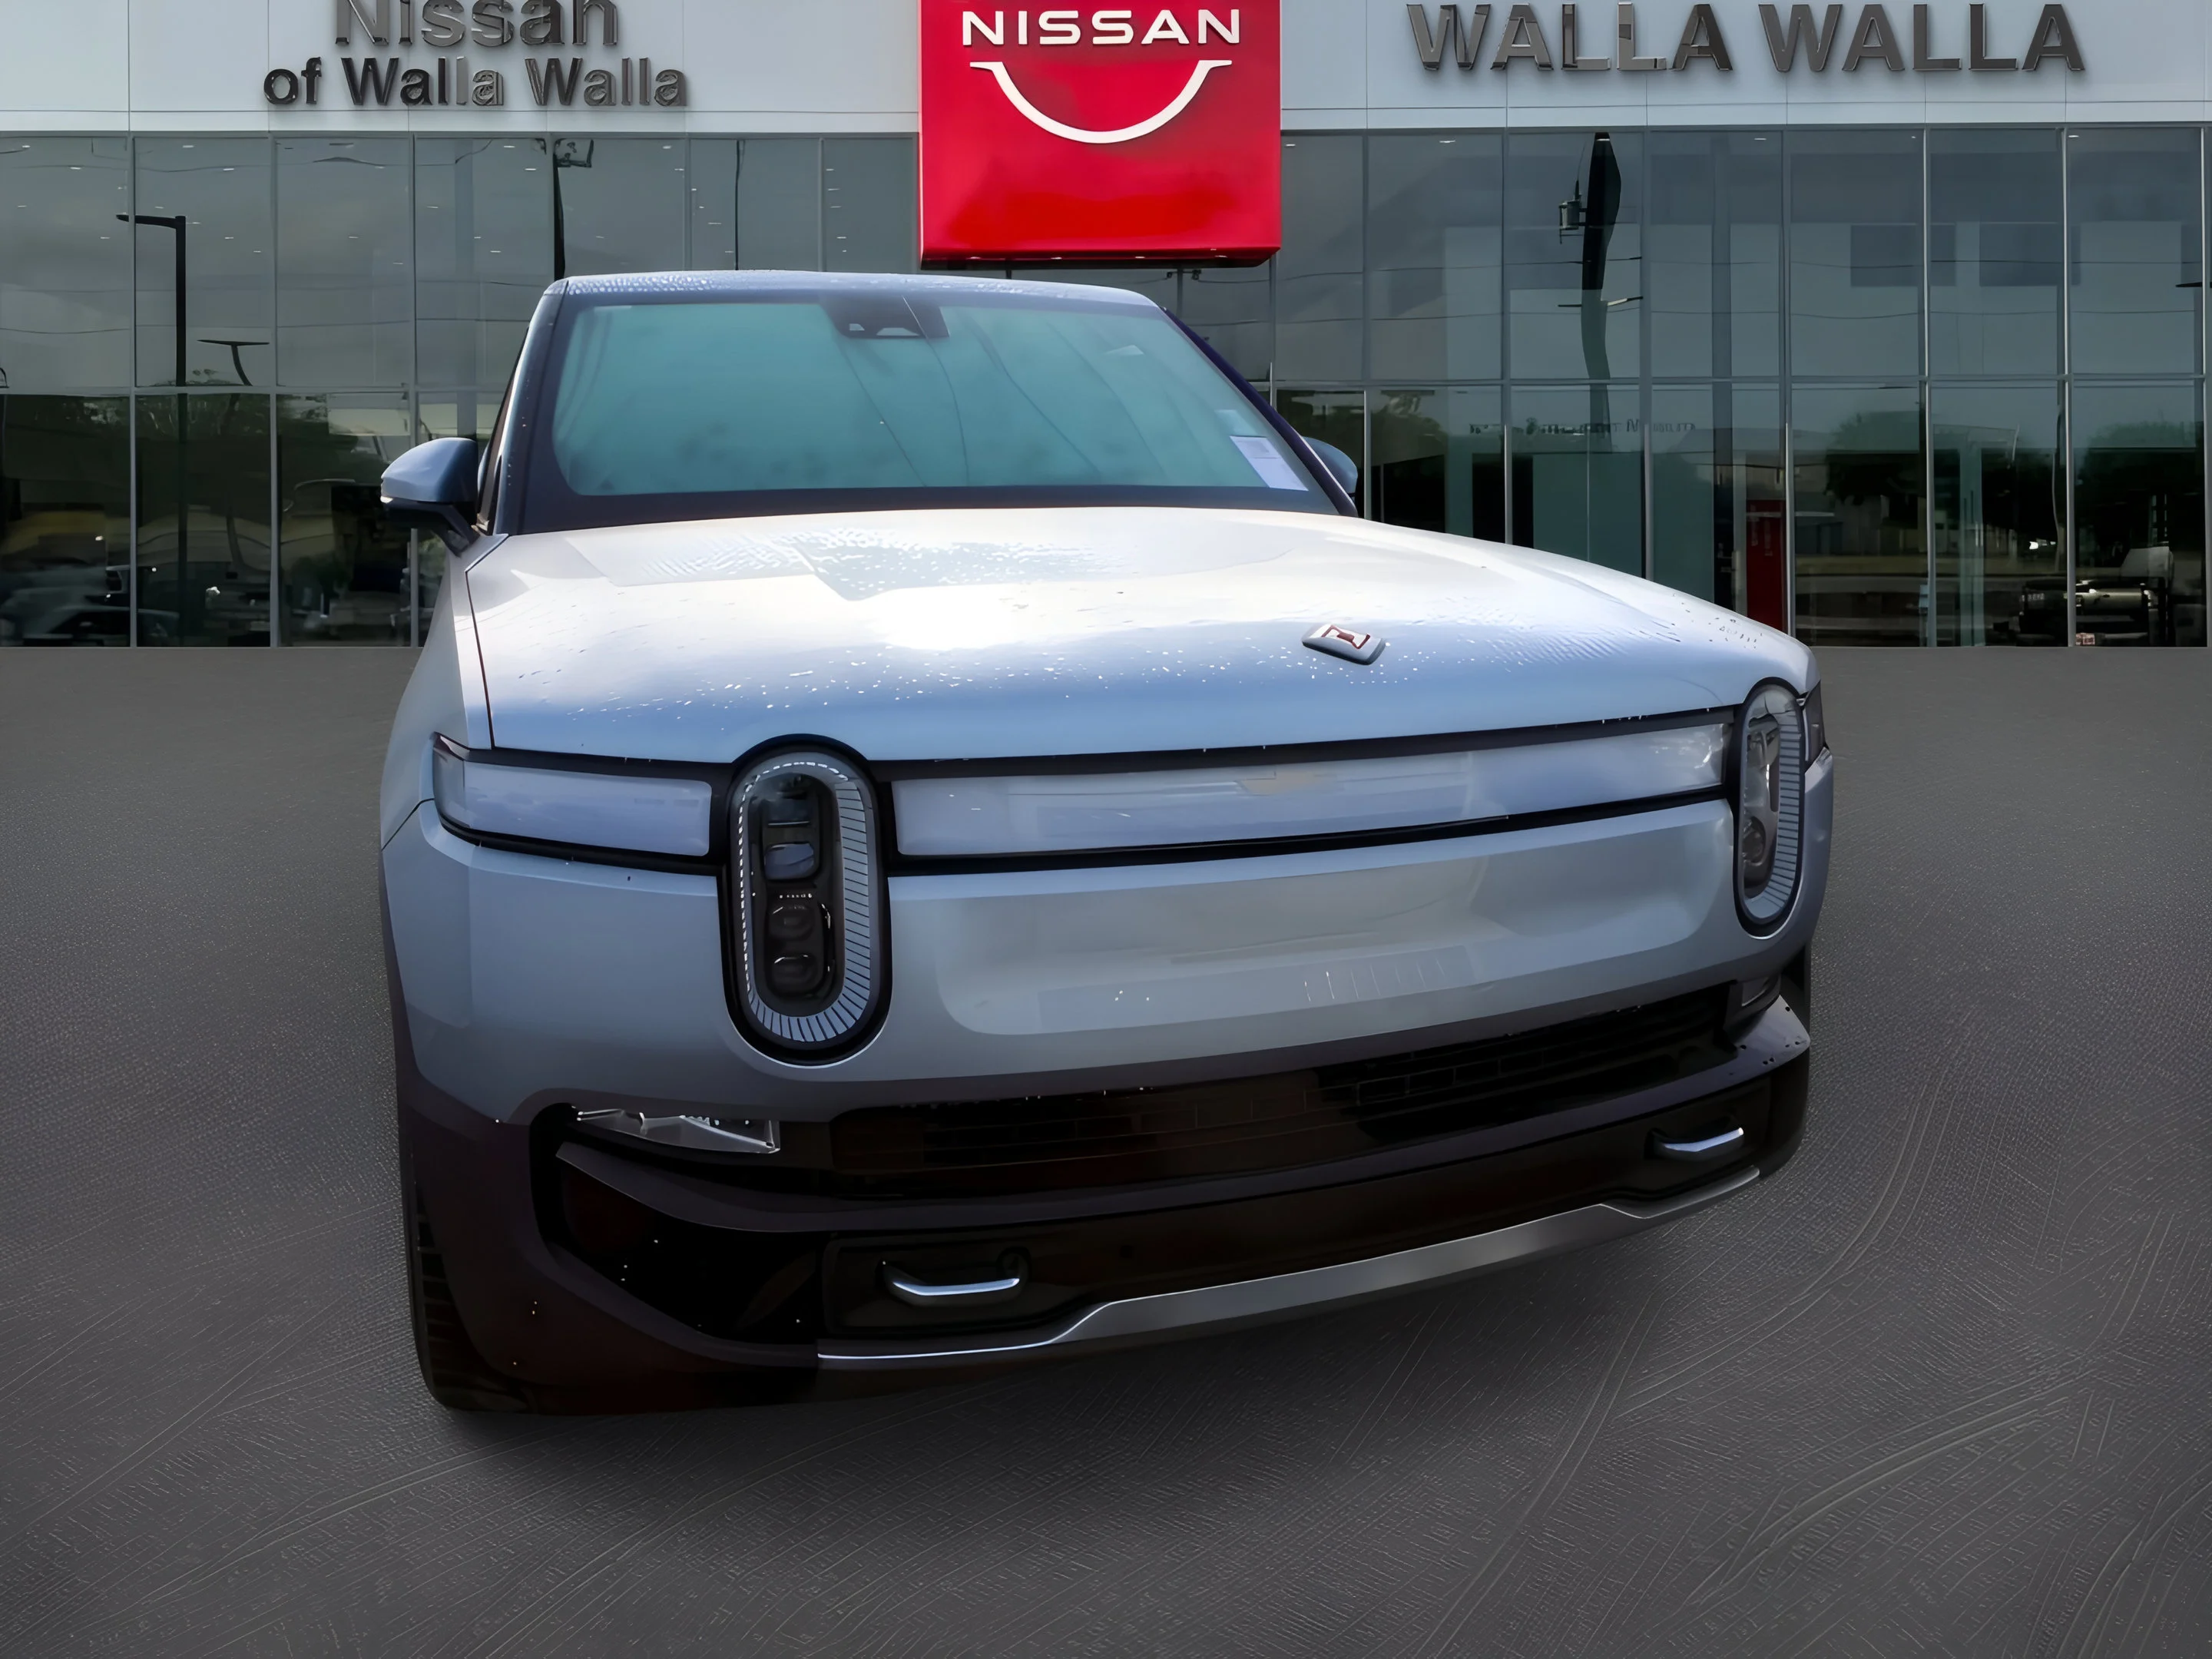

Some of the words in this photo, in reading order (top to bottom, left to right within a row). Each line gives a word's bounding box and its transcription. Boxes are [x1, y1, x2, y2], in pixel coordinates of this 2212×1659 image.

[336, 0, 618, 47] Nissan
[962, 9, 1240, 46] NISSAN
[1407, 3, 1733, 71] WALLA
[1758, 3, 2085, 72] WALLA
[263, 57, 321, 104] of
[341, 57, 503, 106] Walla
[525, 57, 687, 106] Walla
